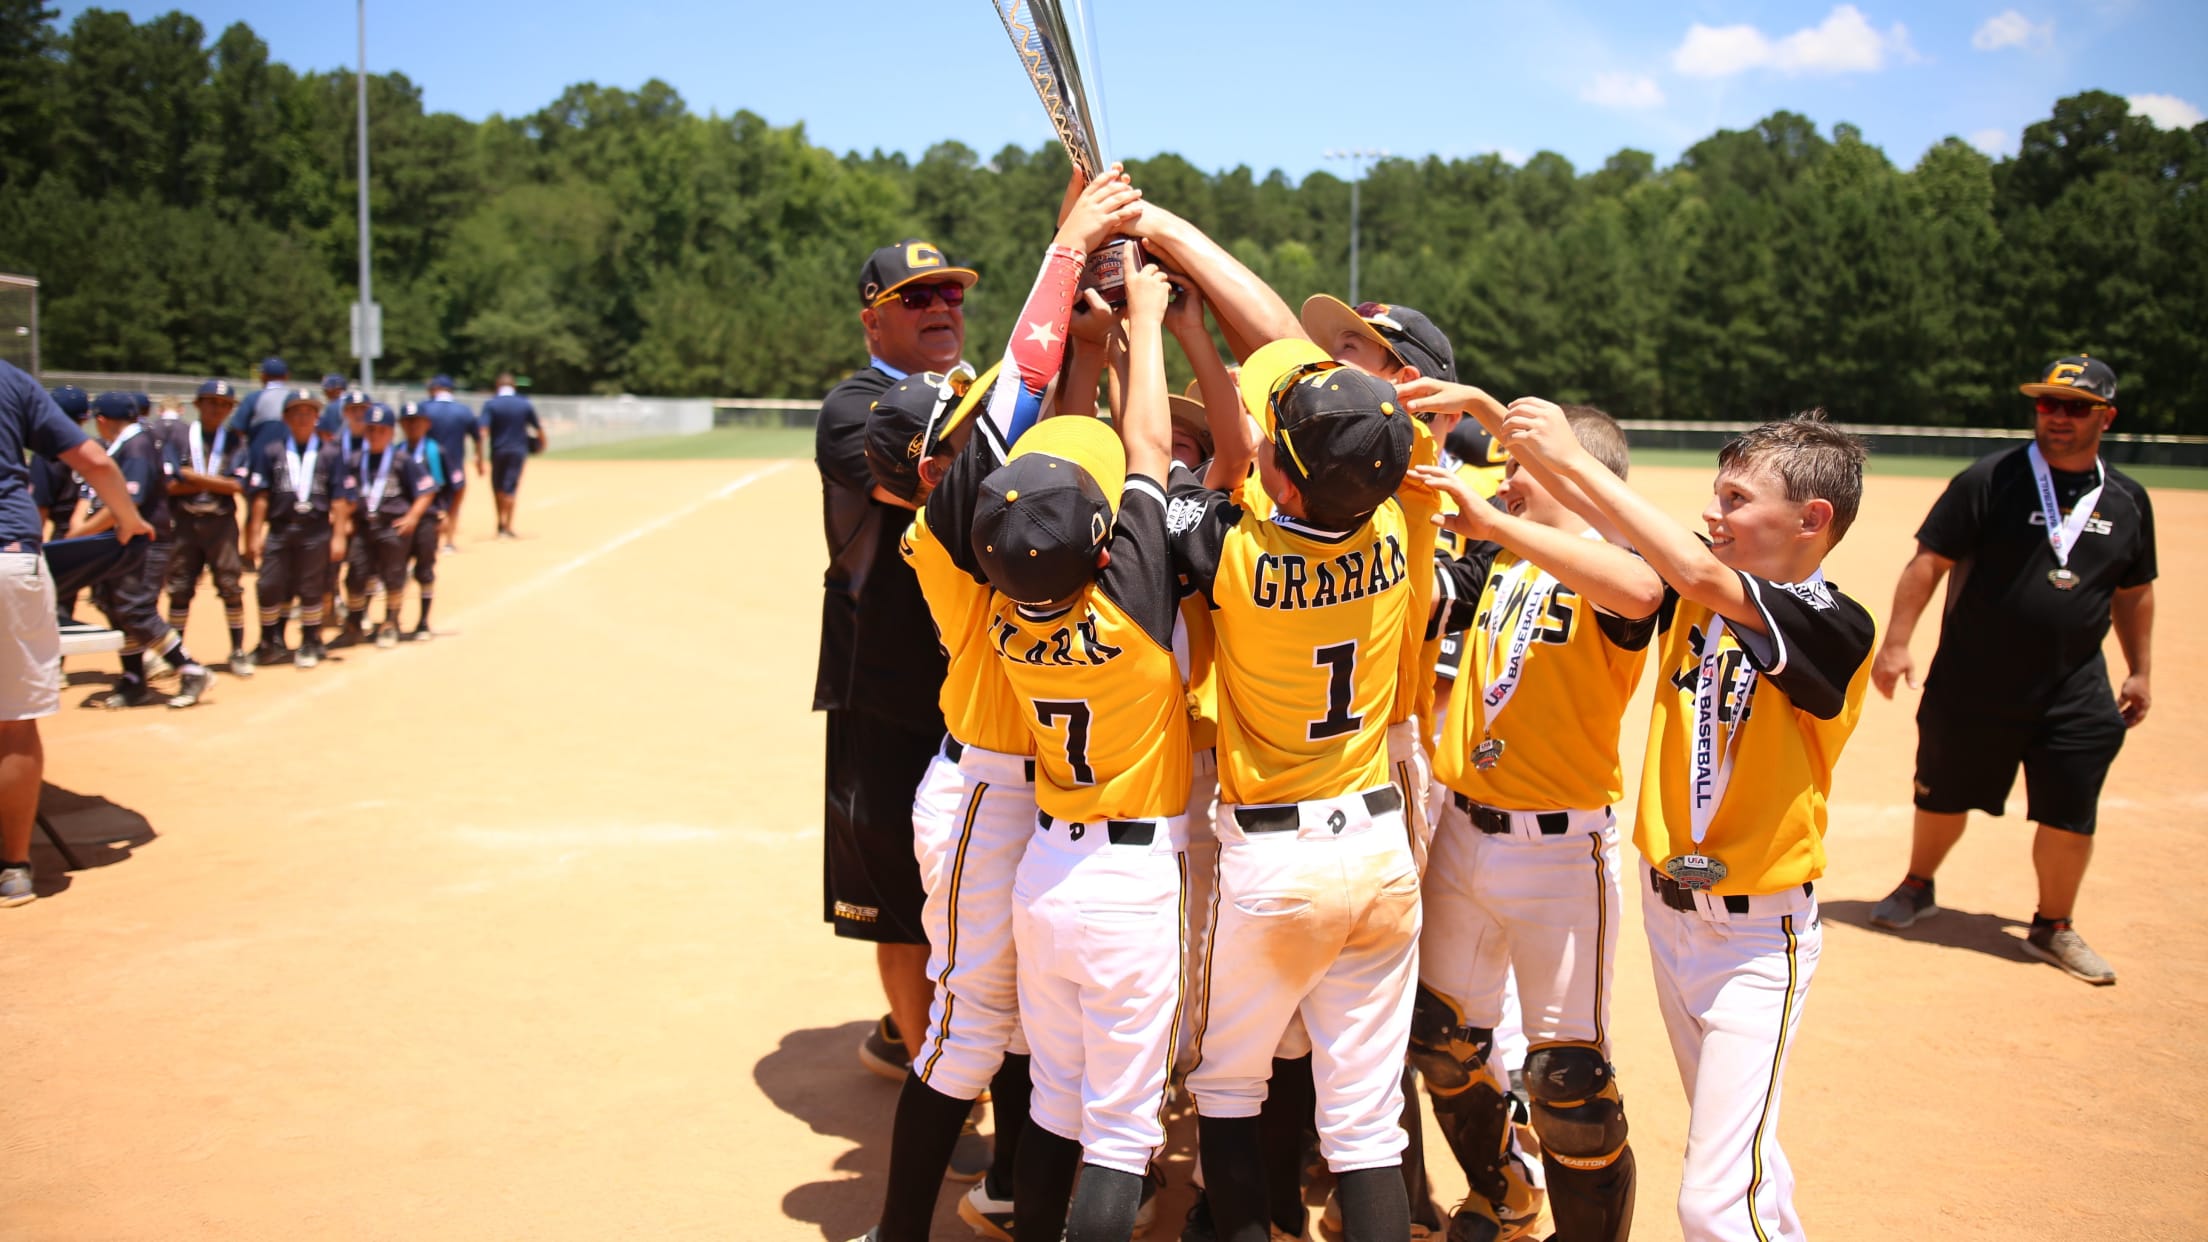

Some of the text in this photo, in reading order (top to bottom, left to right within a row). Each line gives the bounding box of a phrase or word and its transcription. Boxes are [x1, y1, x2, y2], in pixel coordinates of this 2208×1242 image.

[906, 242, 940, 268] C
[2047, 362, 2085, 385] C
[1484, 681, 1512, 707] USA
[1508, 589, 1545, 680] BASEBALL
[1306, 639, 1363, 742] 1
[1030, 698, 1096, 785] 7
[1696, 654, 1714, 809] USA BASEBALL
[1687, 857, 1705, 865] USA
[1564, 1159, 1607, 1167] EASTON
